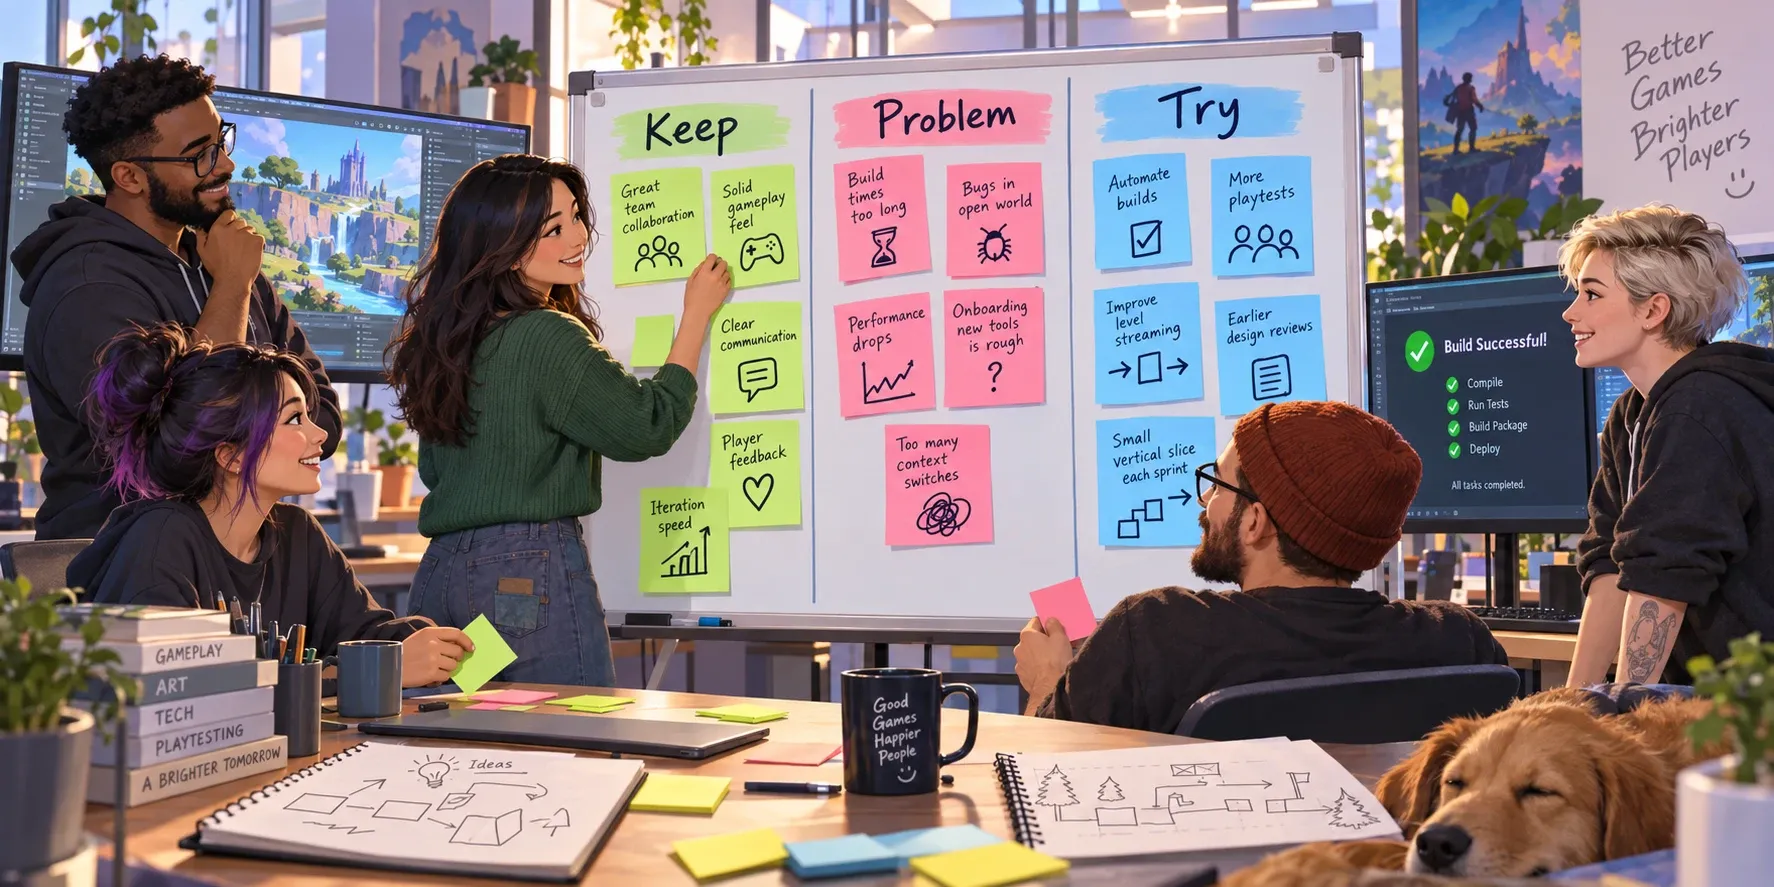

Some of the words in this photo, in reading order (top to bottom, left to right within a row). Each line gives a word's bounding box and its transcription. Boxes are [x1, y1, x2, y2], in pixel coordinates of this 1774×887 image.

[1622, 31, 1714, 76] Better
[1631, 60, 1722, 110] Games
[874, 99, 1016, 139] Problem
[1158, 86, 1239, 139] Try
[646, 113, 738, 156] Keep
[1631, 98, 1739, 161] Brighter
[1660, 129, 1750, 182] Players
[848, 166, 884, 188] Build
[1108, 168, 1170, 192] Automate
[1229, 171, 1264, 187] More
[621, 180, 660, 198] Great
[723, 180, 752, 198] Solid
[848, 188, 884, 205] times
[963, 180, 995, 198] Bugs
[1004, 178, 1015, 189] in
[625, 200, 655, 216] team
[728, 192, 786, 219] gameplay
[959, 203, 989, 220] open
[996, 193, 1032, 210] world
[1118, 189, 1157, 210] builds
[1229, 186, 1295, 212] playtests
[622, 209, 694, 234] collaboration
[851, 211, 872, 223] too
[880, 202, 906, 218] long
[730, 214, 753, 234] feel
[953, 299, 1027, 318] Onboarding
[1106, 295, 1158, 314] Improve
[721, 318, 754, 334] Clear
[848, 308, 925, 333] Performance
[958, 323, 982, 336] new
[989, 317, 1019, 332] tools
[1116, 312, 1143, 330] level
[1228, 308, 1272, 326] Earlier
[721, 331, 796, 351] communication
[853, 333, 892, 352] drops
[1116, 324, 1180, 346] streaming
[1227, 331, 1264, 346] design
[1270, 321, 1313, 337] reviews
[1444, 338, 1472, 353] Build
[1476, 332, 1547, 350] Successful!
[969, 340, 979, 352] is
[987, 334, 1023, 354] rough
[1468, 377, 1503, 390] Compile
[1468, 400, 1484, 410] Run
[1487, 399, 1509, 409] Tests
[1469, 420, 1490, 432] Build
[1493, 420, 1527, 432] Package
[722, 433, 763, 452] Player
[896, 436, 918, 451] Too
[926, 437, 958, 451] many
[1113, 429, 1150, 448] Small
[730, 445, 787, 470] feedback
[1113, 447, 1161, 467] vertical
[1169, 444, 1196, 457] slice
[1470, 443, 1500, 456] Deploy
[897, 453, 948, 471] context
[905, 470, 958, 488] switches
[1123, 467, 1150, 484] each
[1154, 462, 1188, 481] sprint
[1452, 481, 1461, 490] All
[1464, 480, 1482, 490] tasks
[1484, 480, 1525, 491] completed.
[651, 499, 704, 515] Iteration
[659, 516, 692, 537] speed
[156, 643, 223, 664] GAMEPLAY
[156, 676, 188, 696] ART
[873, 693, 908, 713] Good
[155, 705, 194, 726] TECH
[873, 713, 917, 731] Games
[156, 724, 243, 756] PLAYTESTING
[875, 728, 921, 748] Happier
[469, 759, 512, 769] Ideas
[878, 745, 916, 766] People
[142, 776, 152, 792] A
[160, 761, 218, 789] BRIGHTER
[224, 746, 281, 771] TOMORROW
